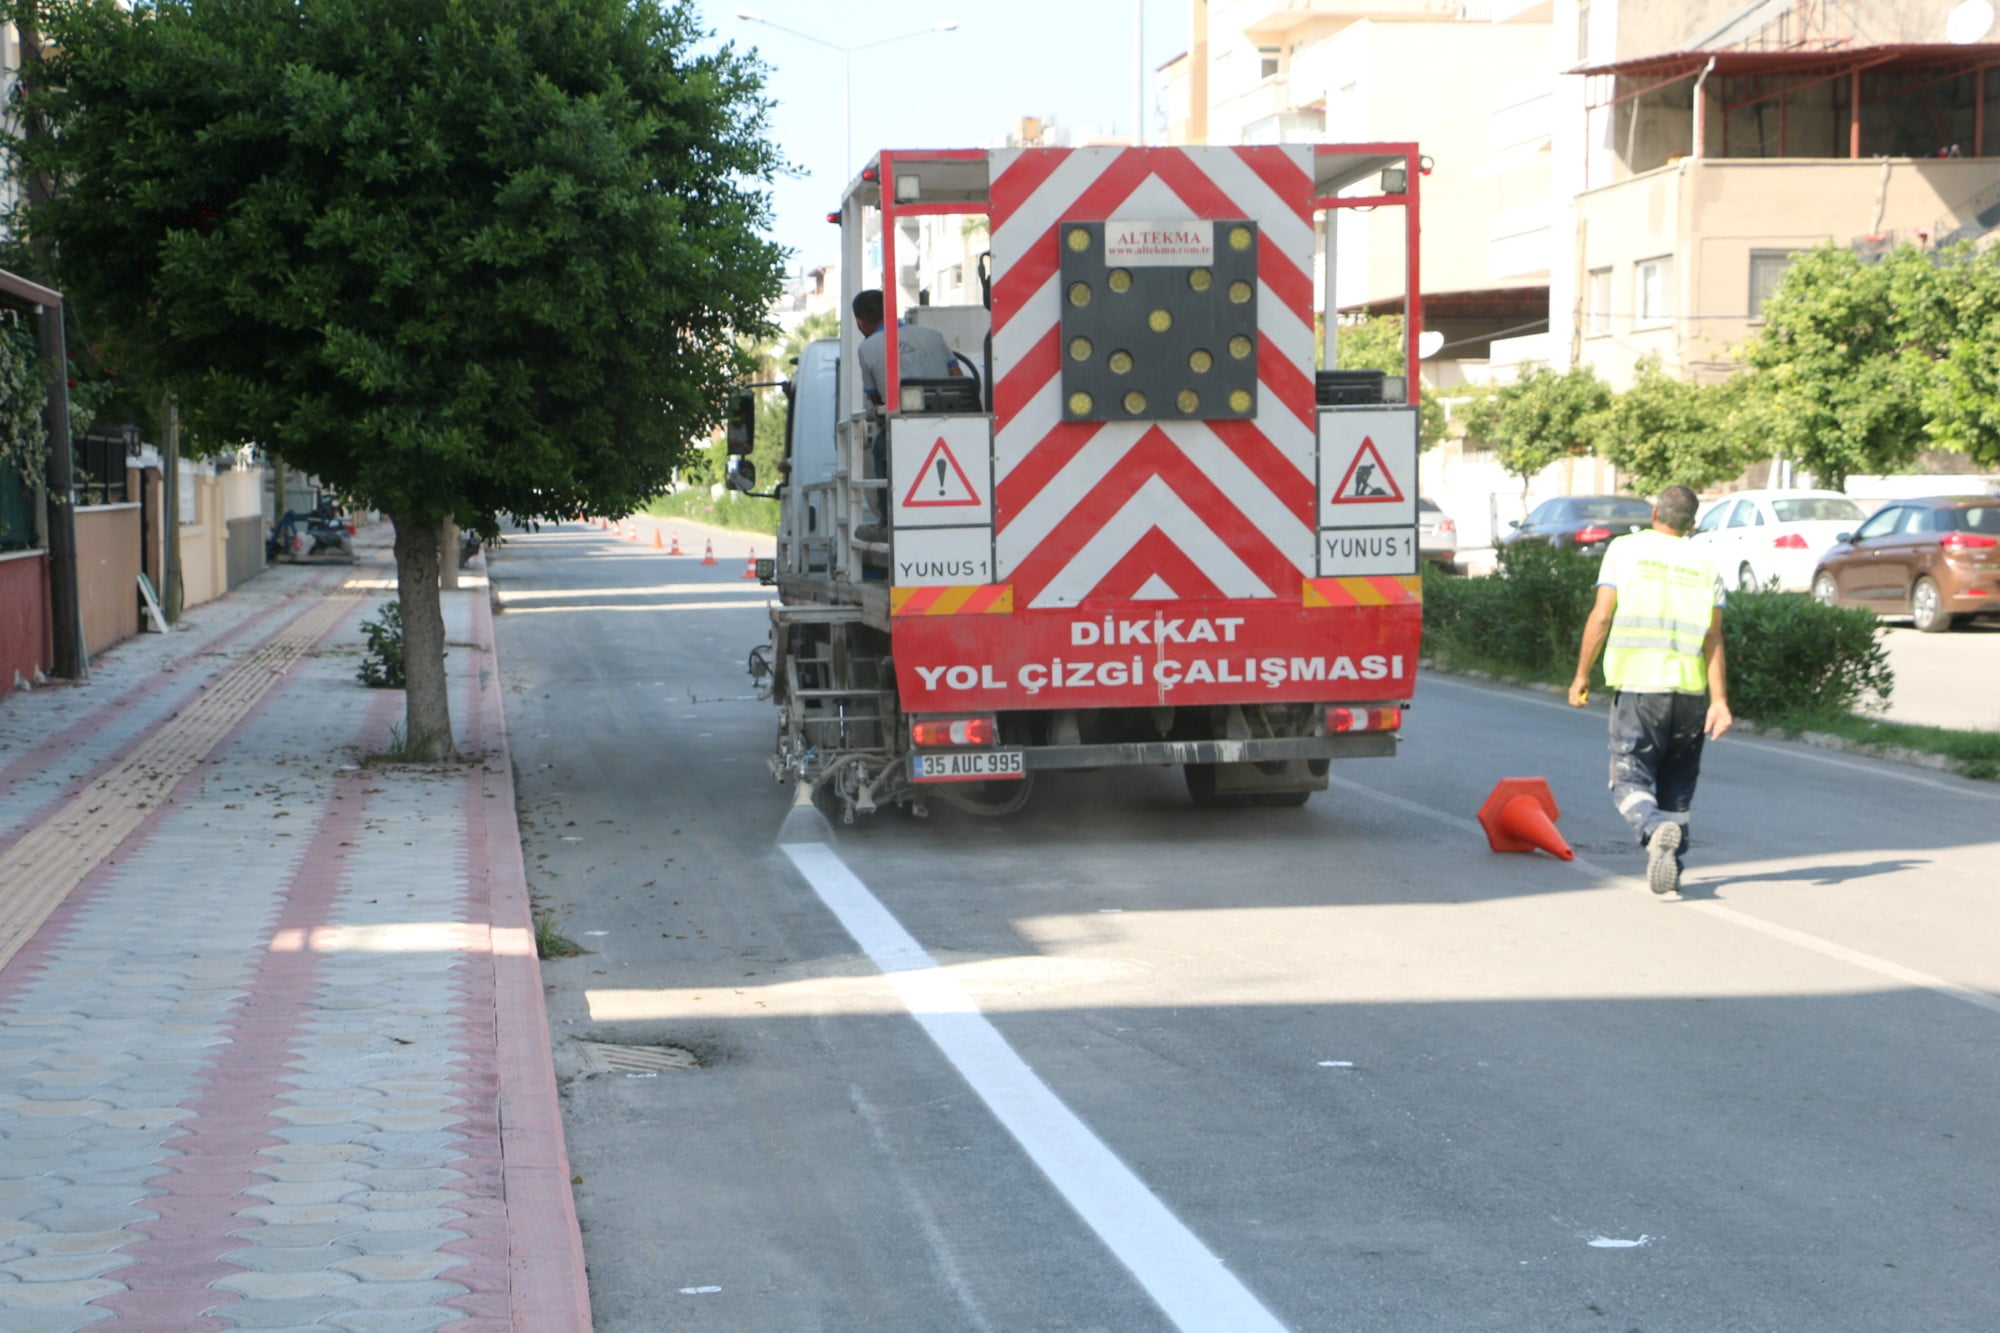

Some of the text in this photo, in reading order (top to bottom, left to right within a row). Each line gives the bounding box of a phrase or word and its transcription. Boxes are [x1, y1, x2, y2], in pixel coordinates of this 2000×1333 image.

[1118, 232, 1201, 244] ALTEKMA
[1108, 246, 1211, 256] www.altekma.com.tr
[1326, 537, 1411, 558] YUNUS 1
[900, 561, 987, 578] YUNUS 1
[1071, 614, 1245, 646] DİKKAT
[914, 655, 1403, 695] YOL ÇİZGİ ÇALIŞMASI
[924, 754, 1020, 775] 35 AUC 995
